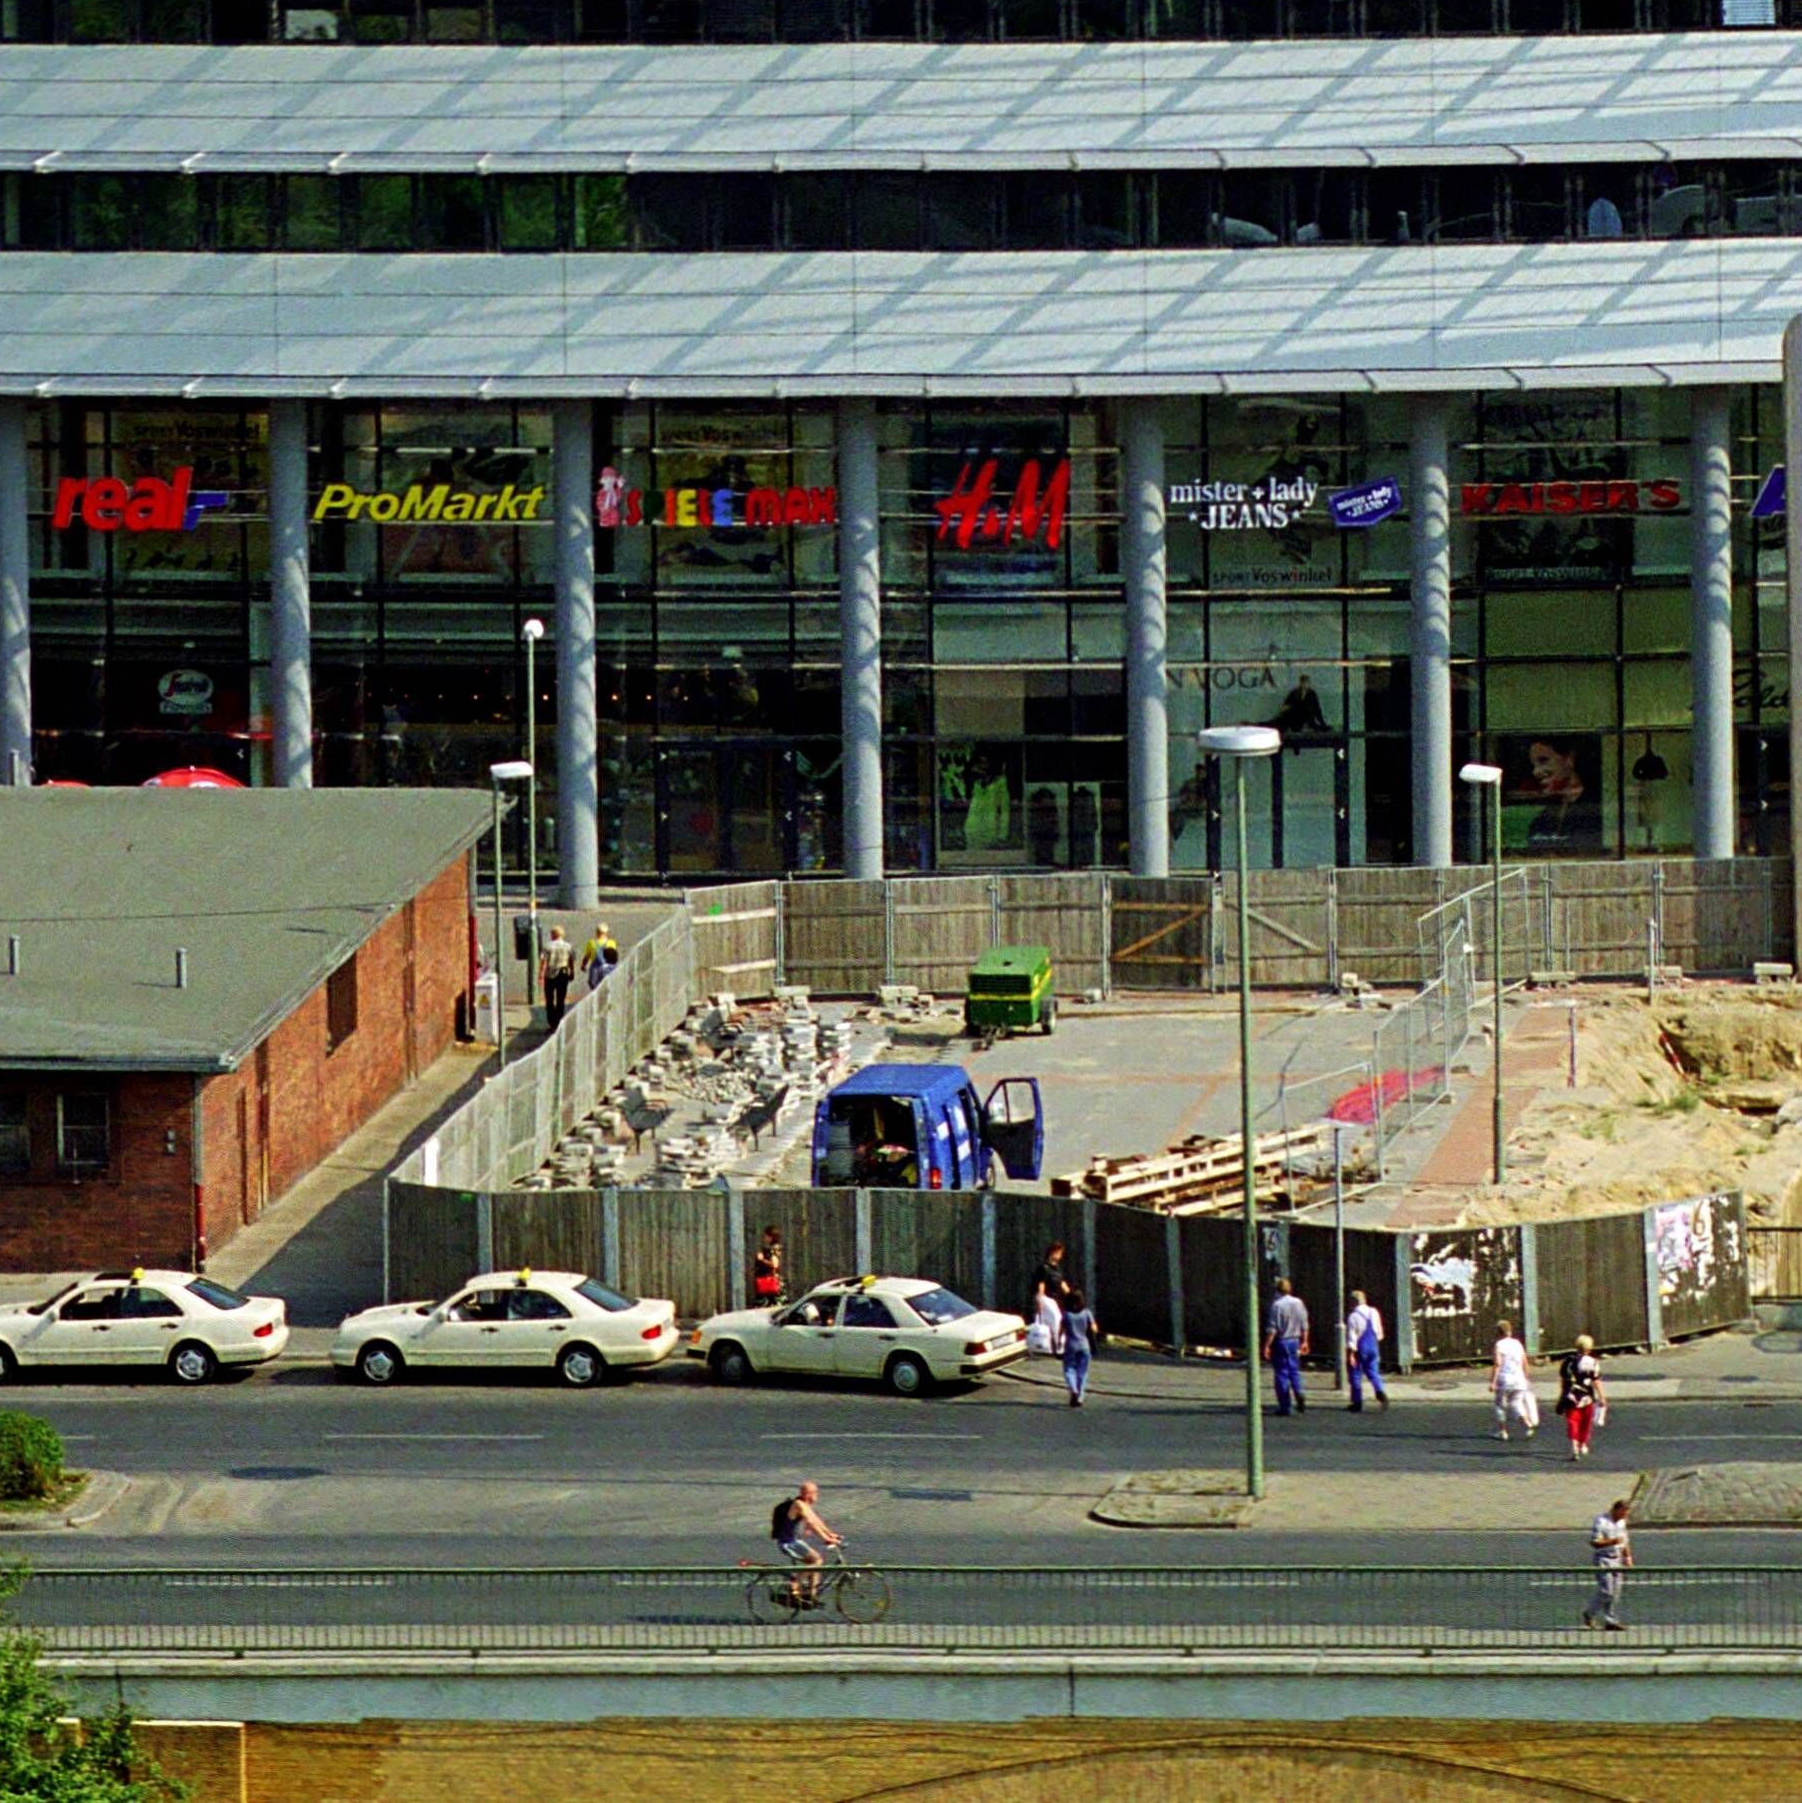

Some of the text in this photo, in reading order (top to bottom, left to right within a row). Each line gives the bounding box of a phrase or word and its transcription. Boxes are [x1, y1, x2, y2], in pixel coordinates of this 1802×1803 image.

[313, 482, 545, 523] ProMarkt
[625, 487, 734, 526] SPIELE
[1170, 478, 1248, 503] mister
[1269, 476, 1318, 506] lady
[1461, 478, 1681, 515] KAISER'S
[1200, 502, 1289, 531] JEANS
